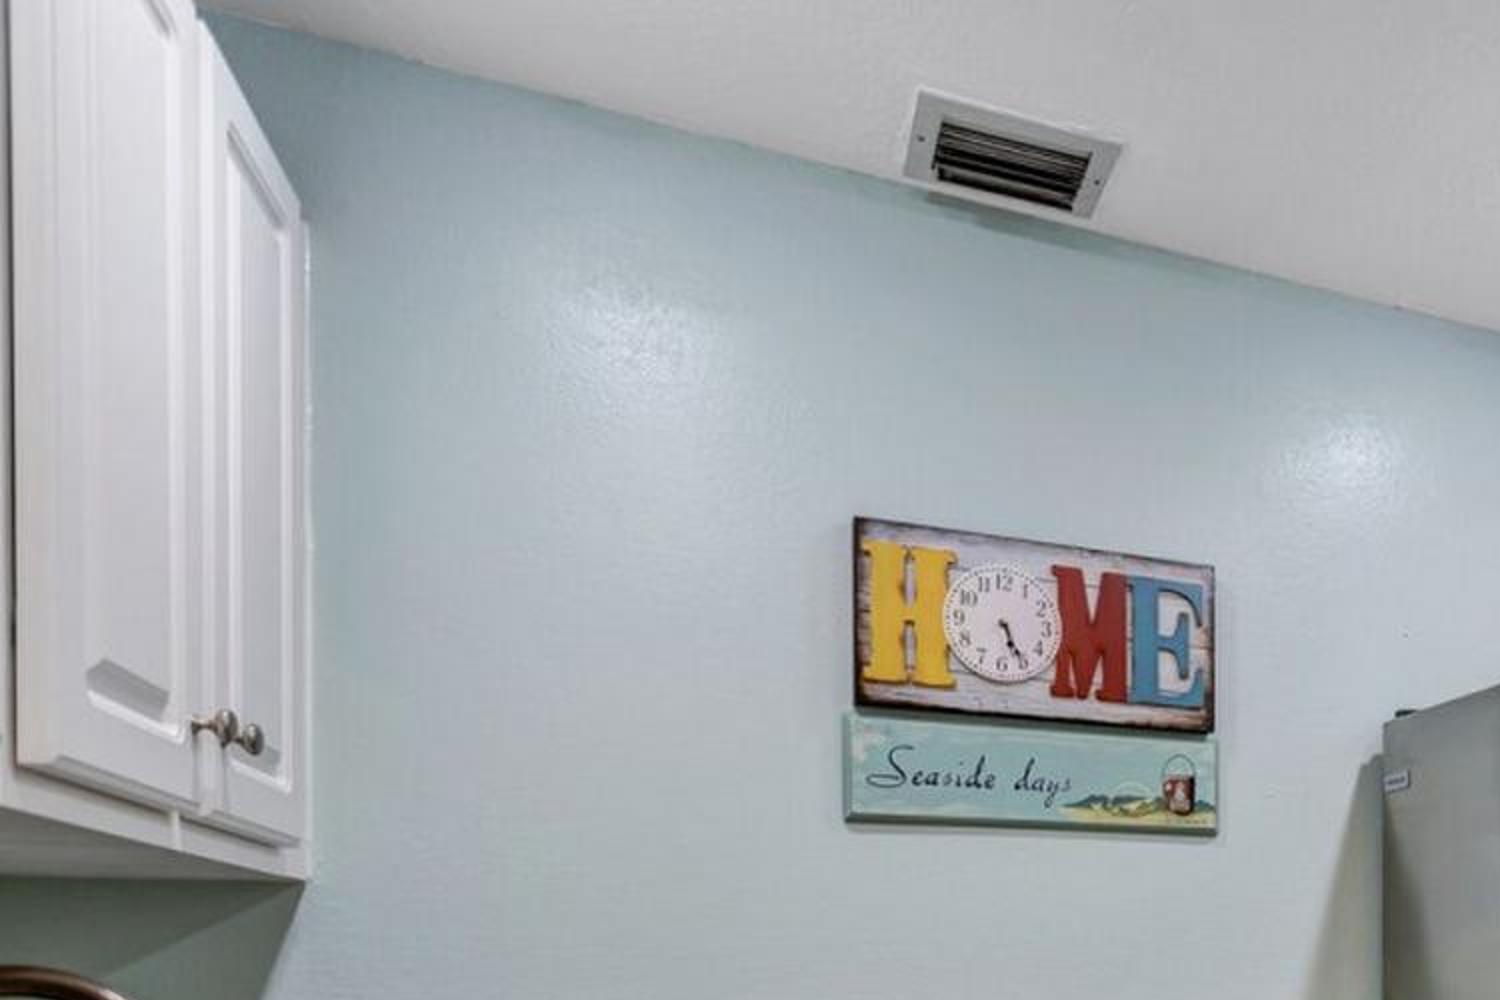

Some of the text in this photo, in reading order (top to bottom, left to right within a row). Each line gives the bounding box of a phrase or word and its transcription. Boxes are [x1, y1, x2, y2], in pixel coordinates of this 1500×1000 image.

[978, 576, 991, 592] 11
[996, 574, 1013, 592] 12
[1022, 583, 1028, 599] 1
[960, 588, 979, 606] 10
[953, 609, 965, 626] 9
[1035, 601, 1046, 618] 2
[1041, 621, 1052, 638] 3
[959, 630, 971, 647] 8
[976, 647, 987, 665] 7
[1032, 640, 1043, 656] 4
[996, 656, 1008, 671] 6
[866, 744, 1072, 808] Seaside days
